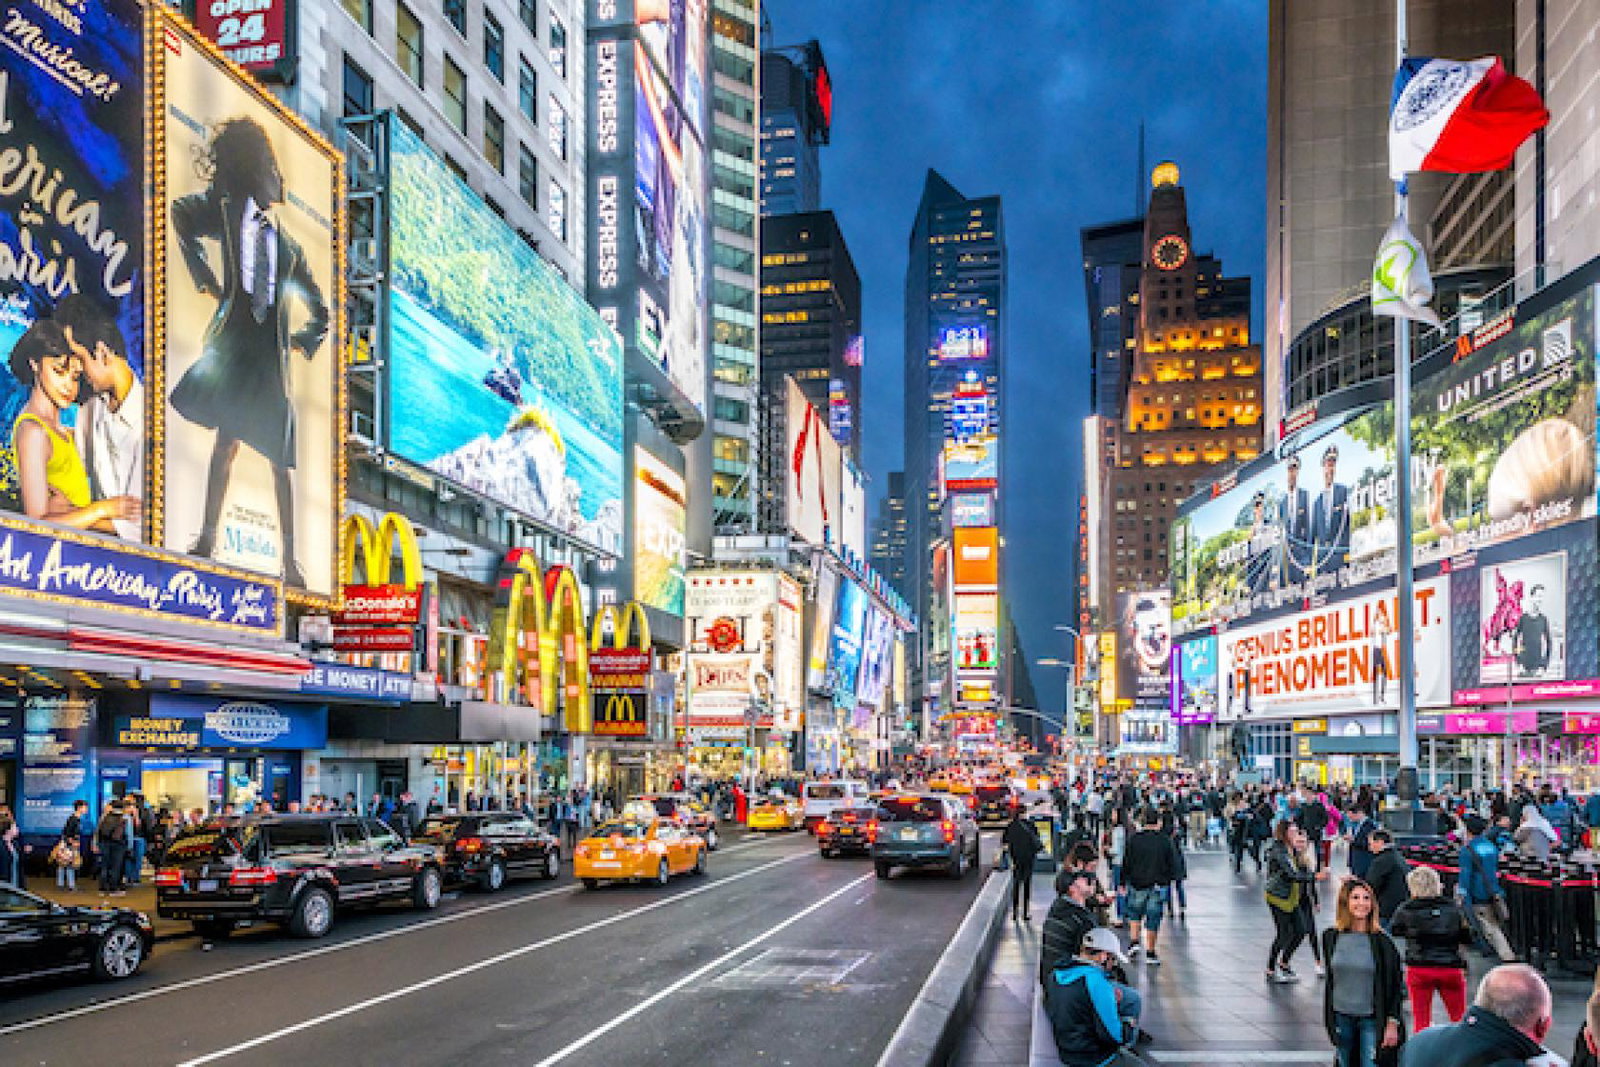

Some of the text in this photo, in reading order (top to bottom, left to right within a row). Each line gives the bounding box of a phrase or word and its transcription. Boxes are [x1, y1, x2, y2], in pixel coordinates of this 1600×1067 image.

[218, 13, 265, 46] 24
[222, 42, 281, 64] OURS
[596, 41, 617, 152] EXPRESS
[596, 175, 618, 289] EXPRESS
[1437, 347, 1537, 412] UNITED
[37, 540, 163, 610] American
[1297, 585, 1441, 654] BRILLIAT.
[327, 669, 377, 691] MONEY
[119, 731, 199, 746] EXCHANGE
